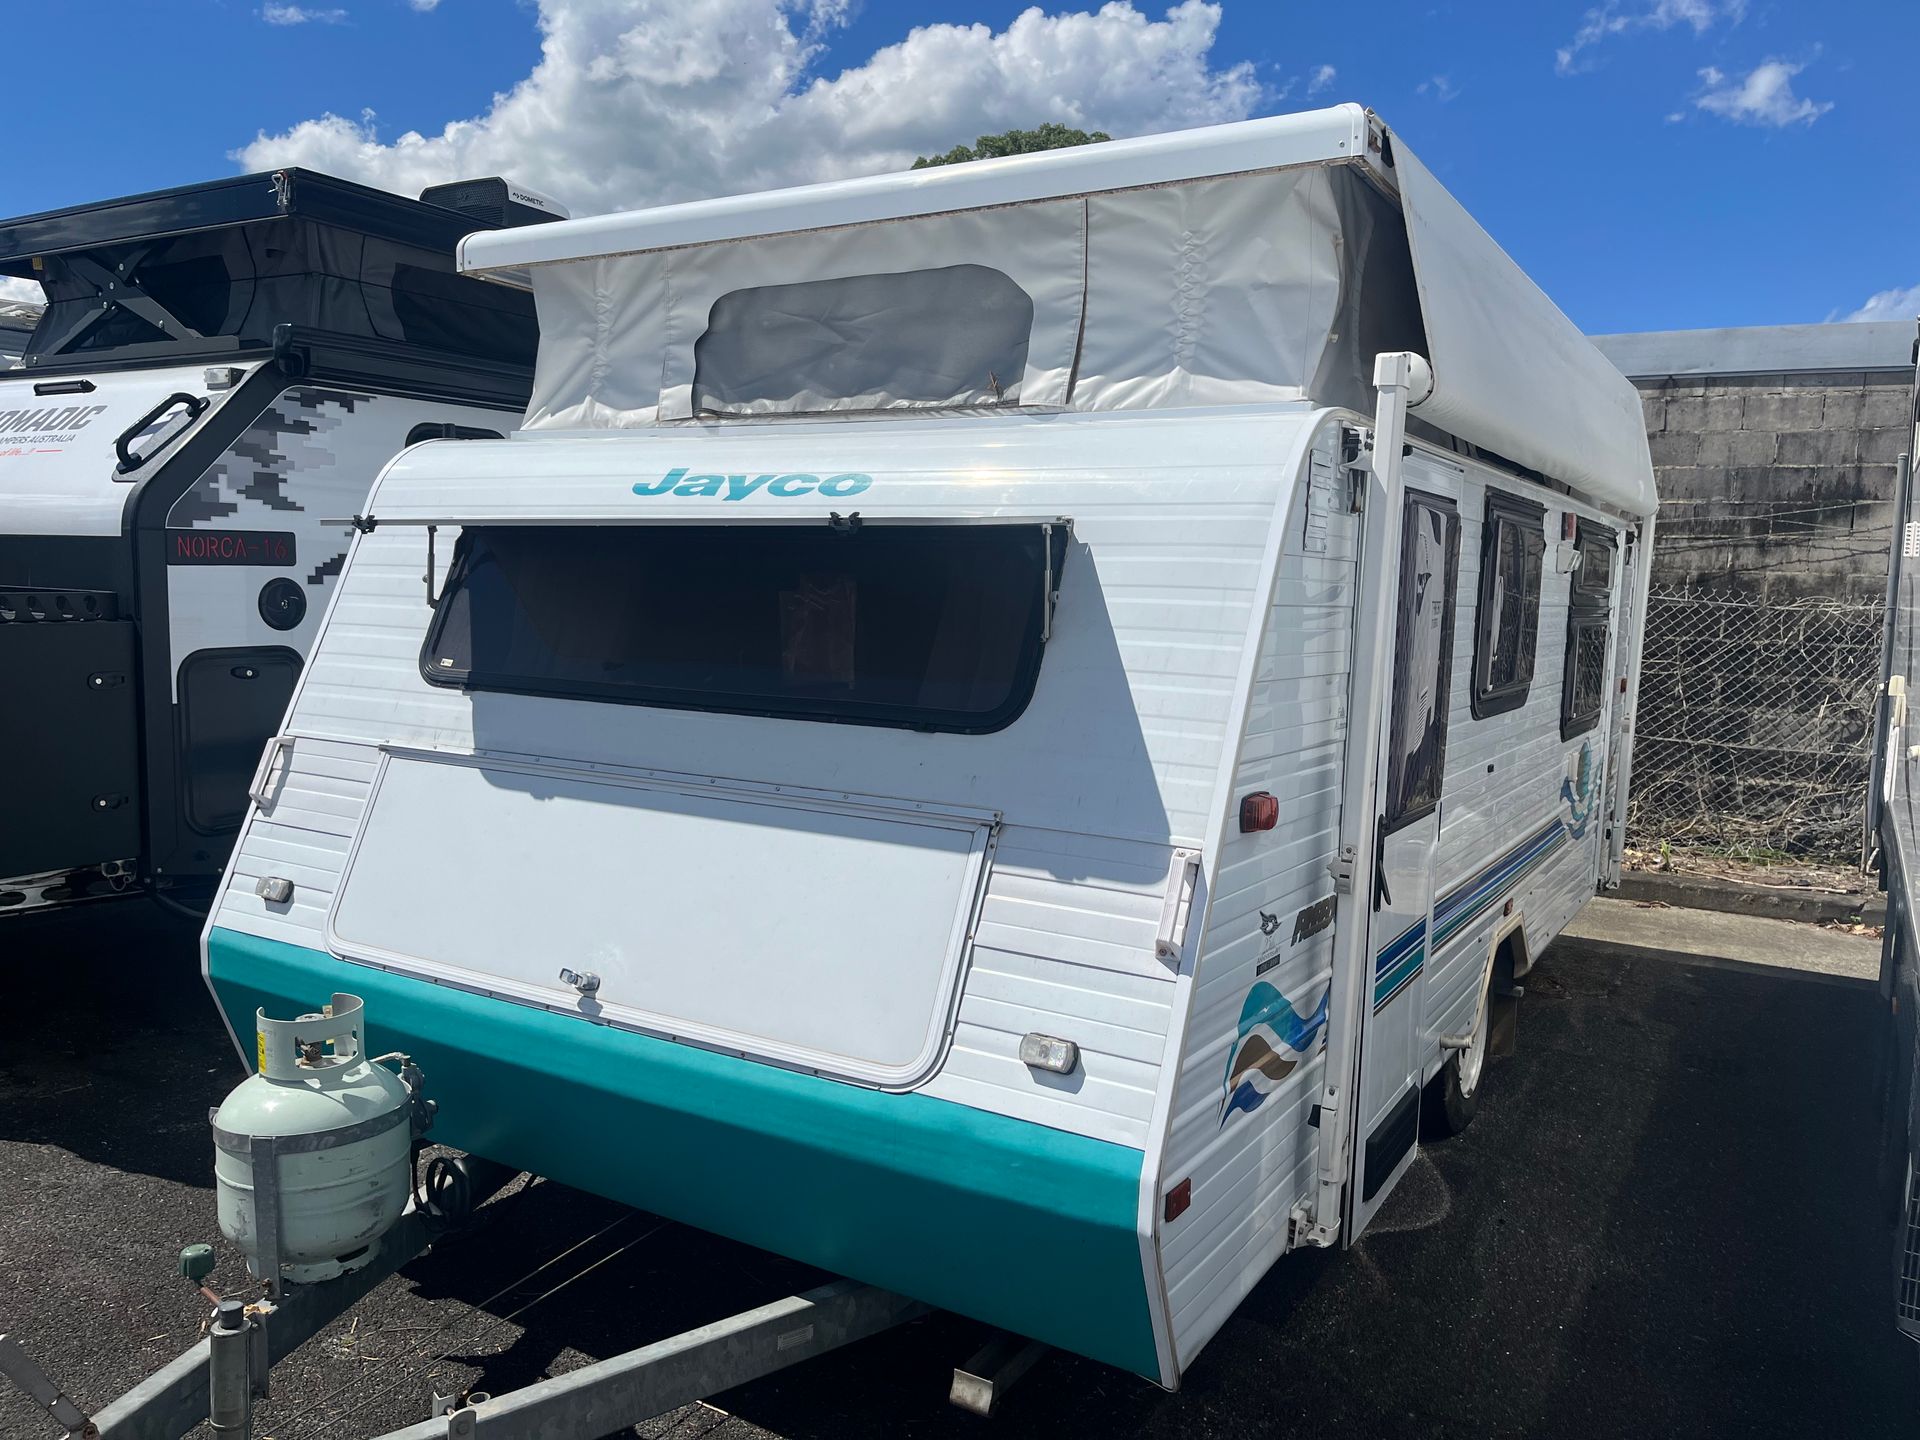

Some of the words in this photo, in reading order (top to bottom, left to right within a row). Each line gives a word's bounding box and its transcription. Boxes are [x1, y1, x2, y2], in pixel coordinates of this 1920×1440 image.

[520, 194, 544, 207] DOMETIC
[0, 405, 108, 433] OMADIC
[28, 434, 76, 443] AUSTRALIA
[632, 468, 873, 501] Jayco
[177, 536, 288, 559] NORCA-16
